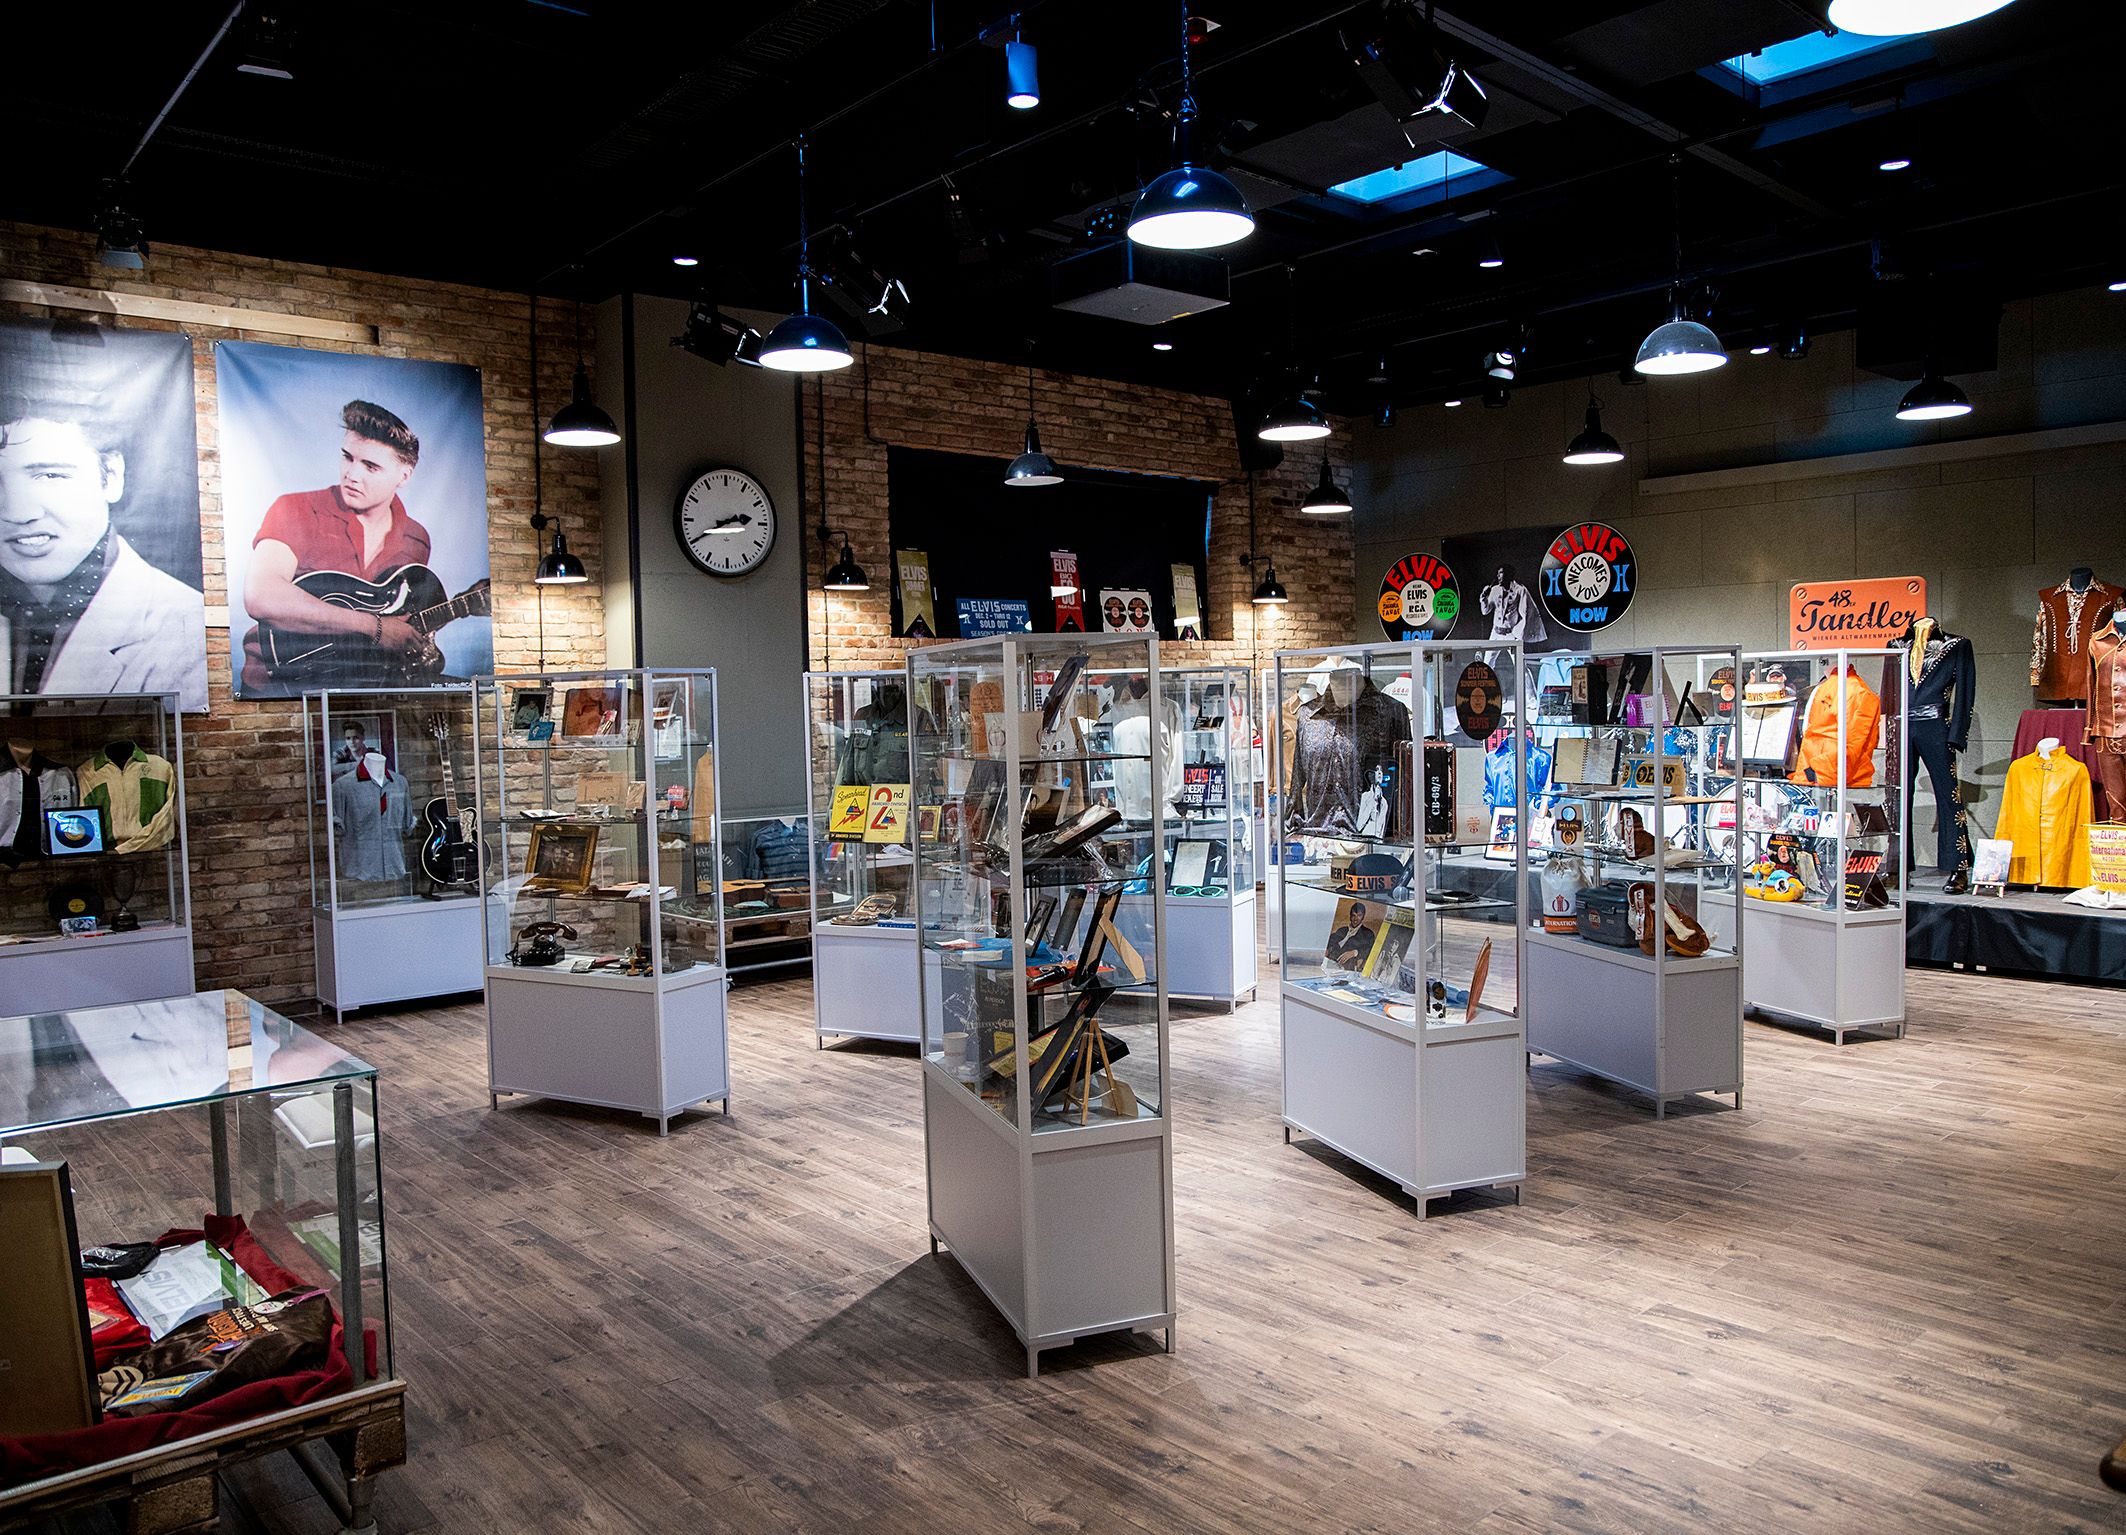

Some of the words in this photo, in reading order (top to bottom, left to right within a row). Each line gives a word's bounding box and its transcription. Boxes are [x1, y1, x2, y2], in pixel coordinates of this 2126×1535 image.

[1549, 525, 1627, 565] ELVIS
[901, 565, 928, 581] ELVIS
[1053, 558, 1077, 574] ELVIS
[1385, 555, 1451, 591] ELVIS
[1567, 556, 1608, 585] WELCOMES
[1173, 574, 1197, 589] ELVIS
[1407, 589, 1428, 601] ELVIS
[1576, 584, 1600, 600] YOU
[1828, 589, 1852, 608] 48
[960, 602, 971, 611] ALL
[970, 600, 1001, 613] ELVIS
[1000, 603, 1027, 612] CONCERTS
[1408, 604, 1426, 613] RCA
[1569, 606, 1608, 624] NOW
[1796, 600, 1917, 633] Tandler
[979, 620, 996, 629] SOLD
[997, 620, 1010, 629] OUT
[1402, 629, 1434, 641] NOW
[1840, 632, 1901, 640] ALTWARENMARKT
[1467, 667, 1489, 680] ELVIS
[1184, 768, 1208, 784] LVIS
[1211, 785, 1224, 793] SALE
[1431, 776, 1441, 816] CB-69/3
[1626, 811, 1635, 853] ELVIS
[2101, 830, 2118, 840] ELVIS
[1845, 856, 1882, 874] ELVIS
[1357, 877, 1385, 890] ELVIS
[2101, 873, 2119, 883] ELVIS
[1636, 892, 1646, 936] ELVIS
